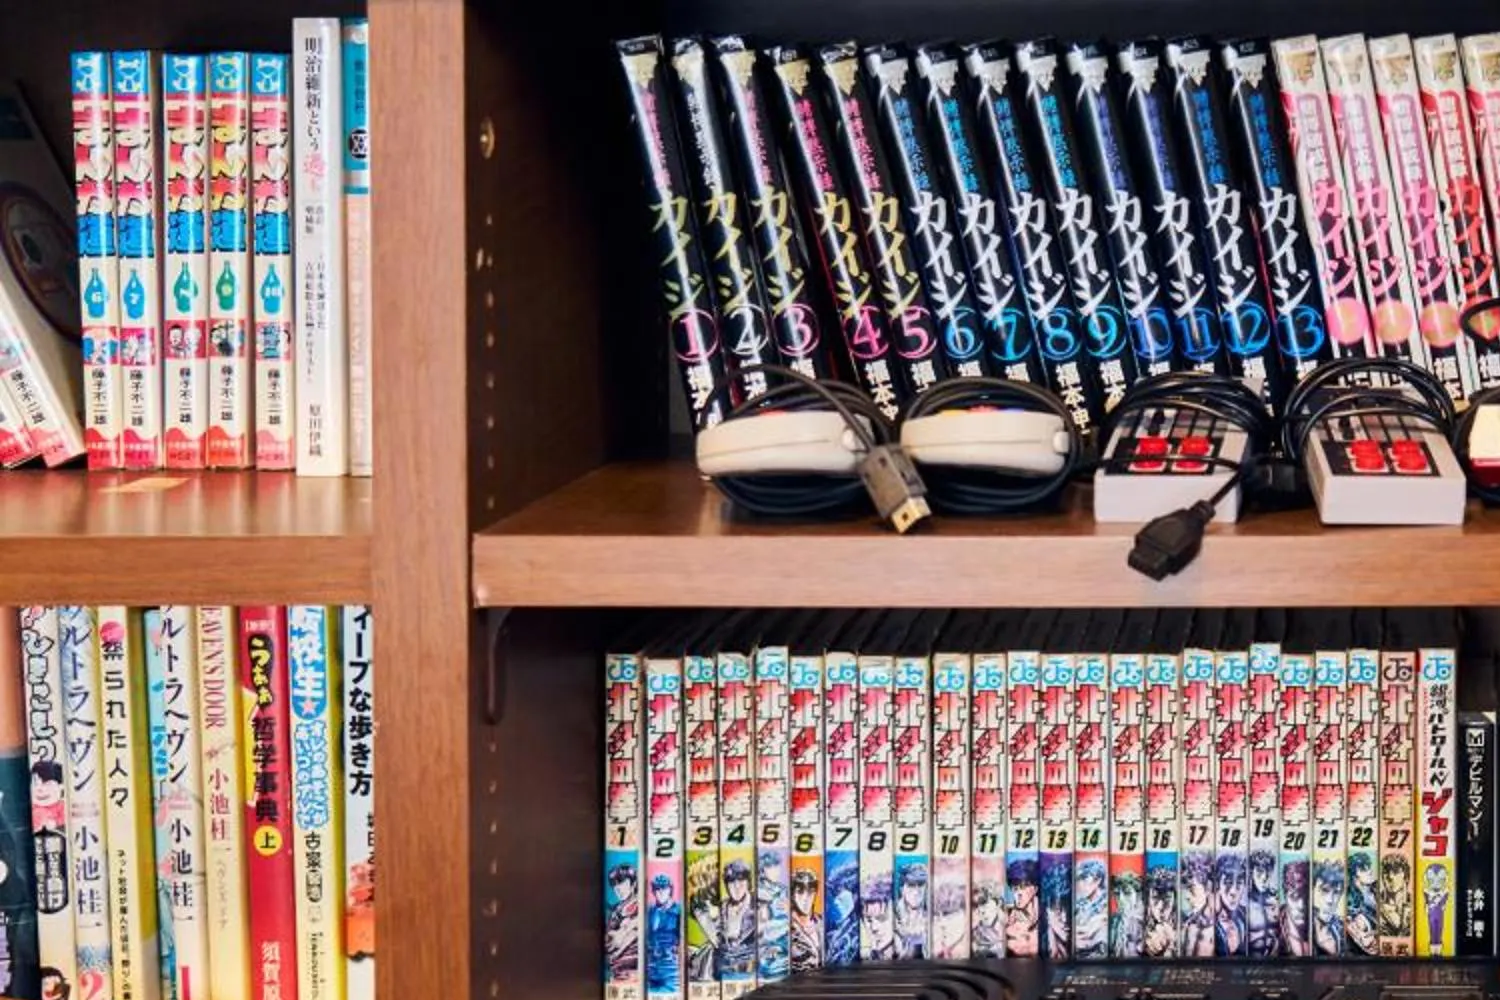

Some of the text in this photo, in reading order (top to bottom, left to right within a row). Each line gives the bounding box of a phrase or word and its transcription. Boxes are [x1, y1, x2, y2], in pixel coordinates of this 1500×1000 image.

[650, 192, 703, 322] カイジ
[704, 192, 768, 353] カイジ 2
[815, 191, 882, 351] カイジ 4
[909, 191, 976, 352] カイジ 6
[959, 191, 1017, 319] カイジ
[1009, 191, 1077, 352] カイジ 8
[1056, 187, 1118, 349] カイジ 9
[1154, 189, 1207, 318] カイジ
[1204, 183, 1268, 349] カイジ 12
[1259, 187, 1311, 316] カイジ
[784, 306, 813, 354] 3
[901, 308, 930, 352] 5
[1131, 309, 1171, 352] 10
[162, 606, 189, 783] ルトラヘヴン
[259, 832, 276, 849] 上
[615, 827, 628, 847] 1
[693, 826, 713, 846] 3
[795, 833, 815, 852] 6
[834, 828, 852, 846] 7
[1015, 829, 1035, 848] 12
[1188, 825, 1207, 844] 17
[1221, 828, 1241, 847] 18
[1254, 818, 1273, 837] 19
[1284, 832, 1305, 849] 20
[1351, 828, 1373, 846] 22
[1387, 830, 1409, 848] 27
[1422, 788, 1453, 856] ジャコ
[656, 838, 675, 857] 2
[940, 835, 960, 854] 10
[74, 826, 101, 928] 小池桂一
[170, 820, 194, 921] 小池桂一
